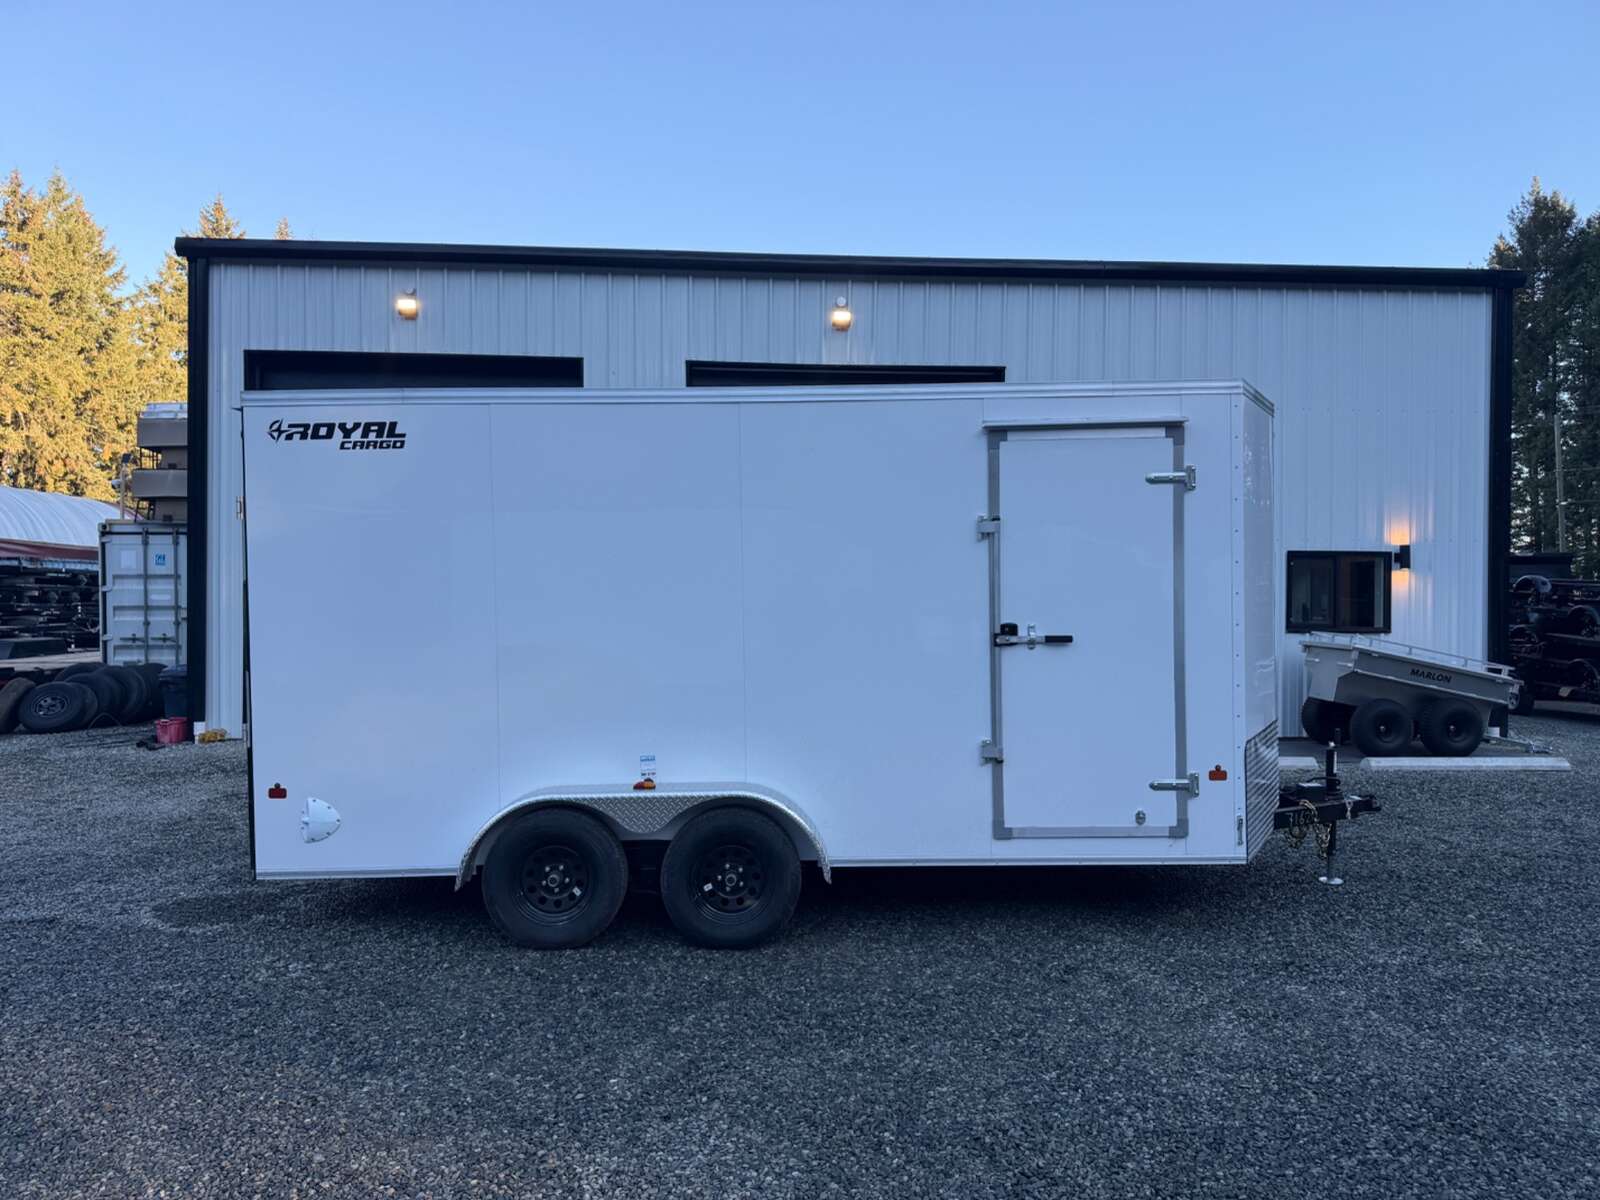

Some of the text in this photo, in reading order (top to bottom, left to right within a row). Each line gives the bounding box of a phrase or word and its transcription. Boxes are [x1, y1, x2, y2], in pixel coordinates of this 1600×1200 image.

[284, 421, 406, 441] ROYAL
[339, 440, 406, 450] CARGO
[1410, 668, 1452, 683] MARLON
